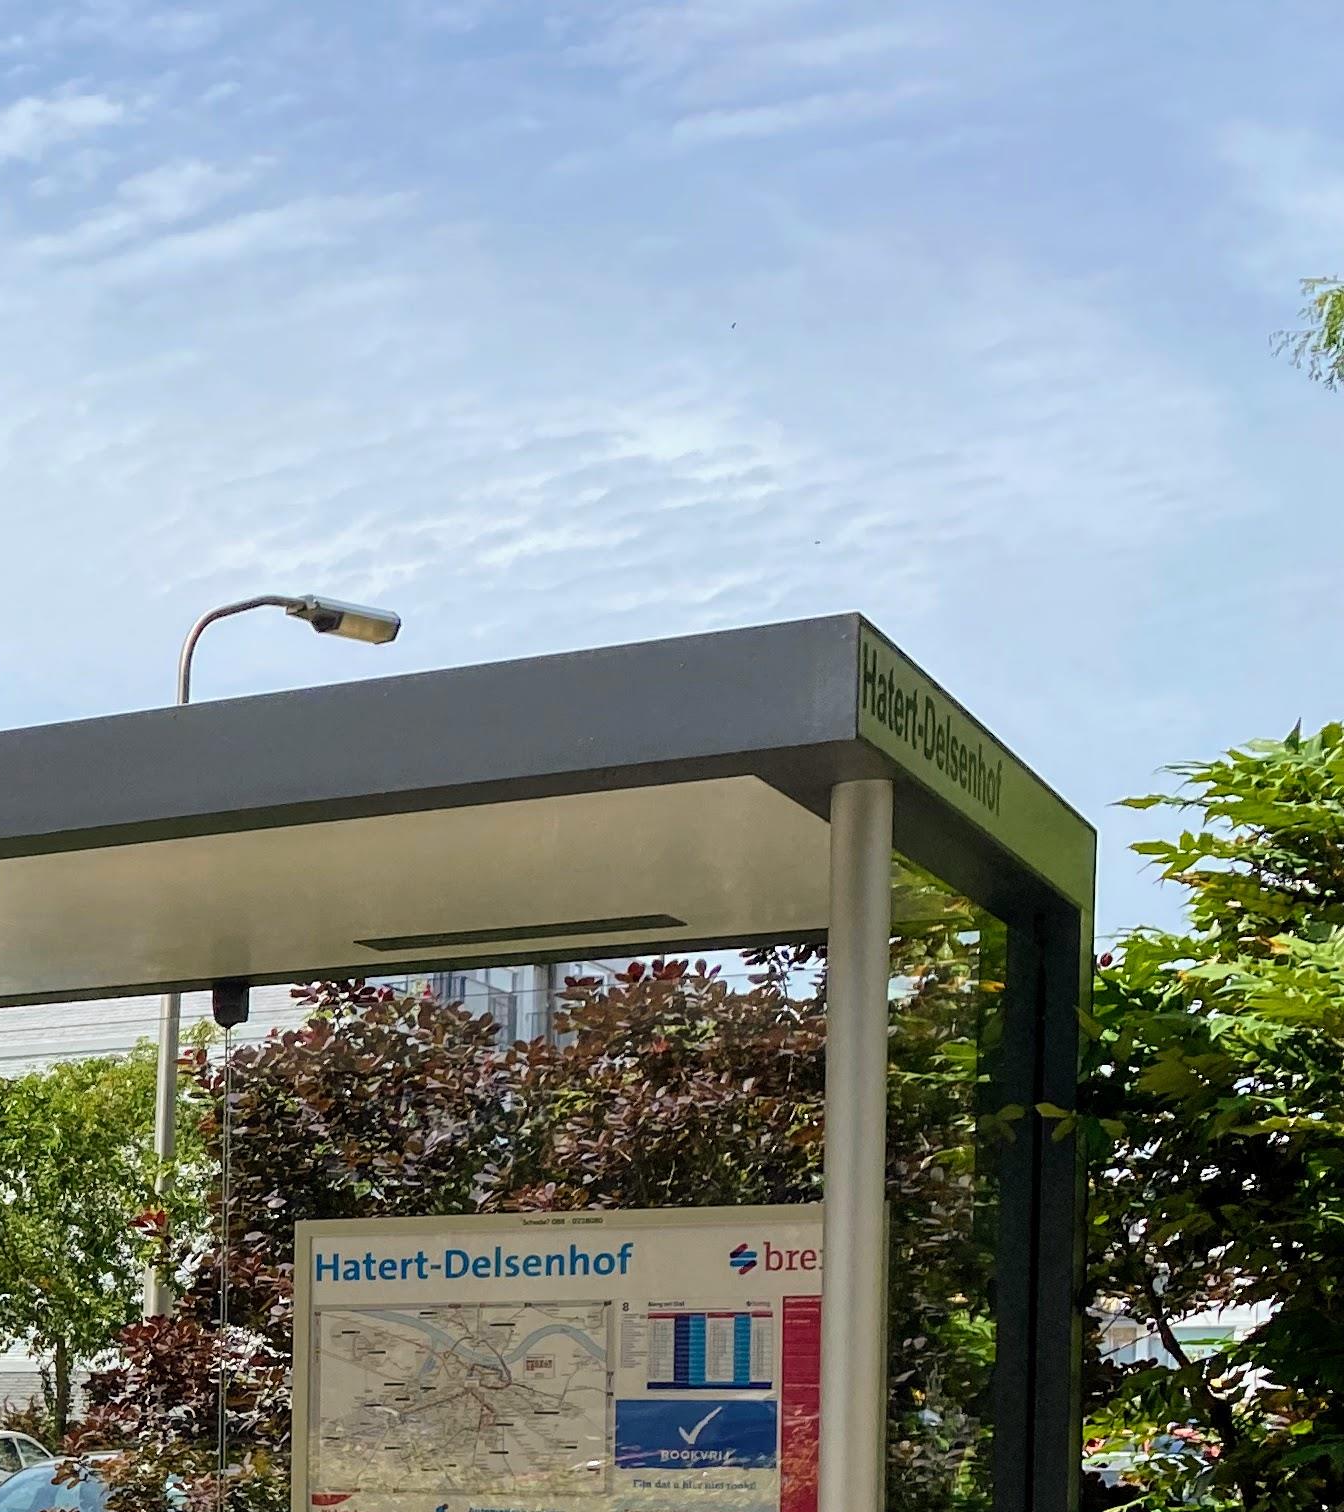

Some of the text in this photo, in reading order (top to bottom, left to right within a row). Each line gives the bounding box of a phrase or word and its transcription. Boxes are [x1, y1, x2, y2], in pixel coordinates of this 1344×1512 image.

[861, 642, 1003, 816] Hatert-Delsenhof
[315, 1242, 634, 1282] Hatert-Delsenhof
[764, 1241, 823, 1271] bre
